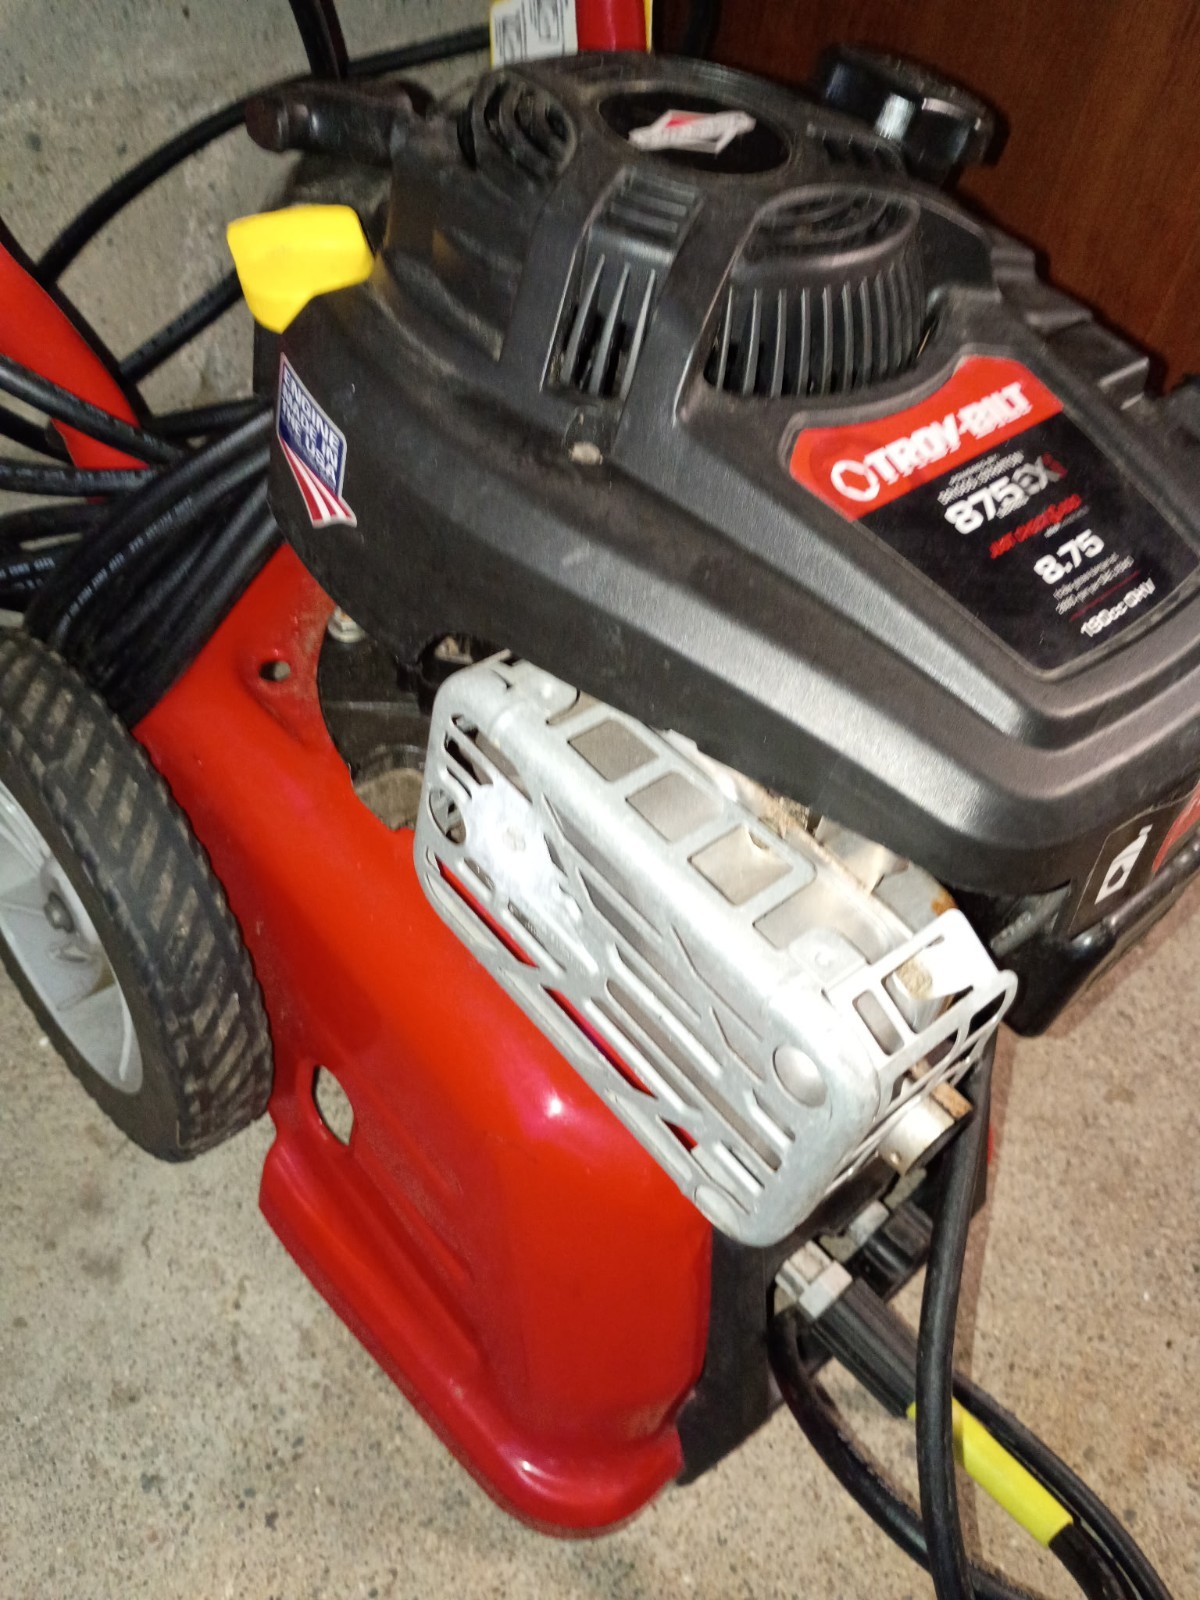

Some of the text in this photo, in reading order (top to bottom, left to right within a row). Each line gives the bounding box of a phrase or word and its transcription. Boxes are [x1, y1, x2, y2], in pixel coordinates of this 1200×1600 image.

[282, 384, 338, 472] MADE IN
[282, 396, 337, 487] THE USA
[283, 364, 340, 447] ENGINE
[1034, 529, 1105, 584] 8.75
